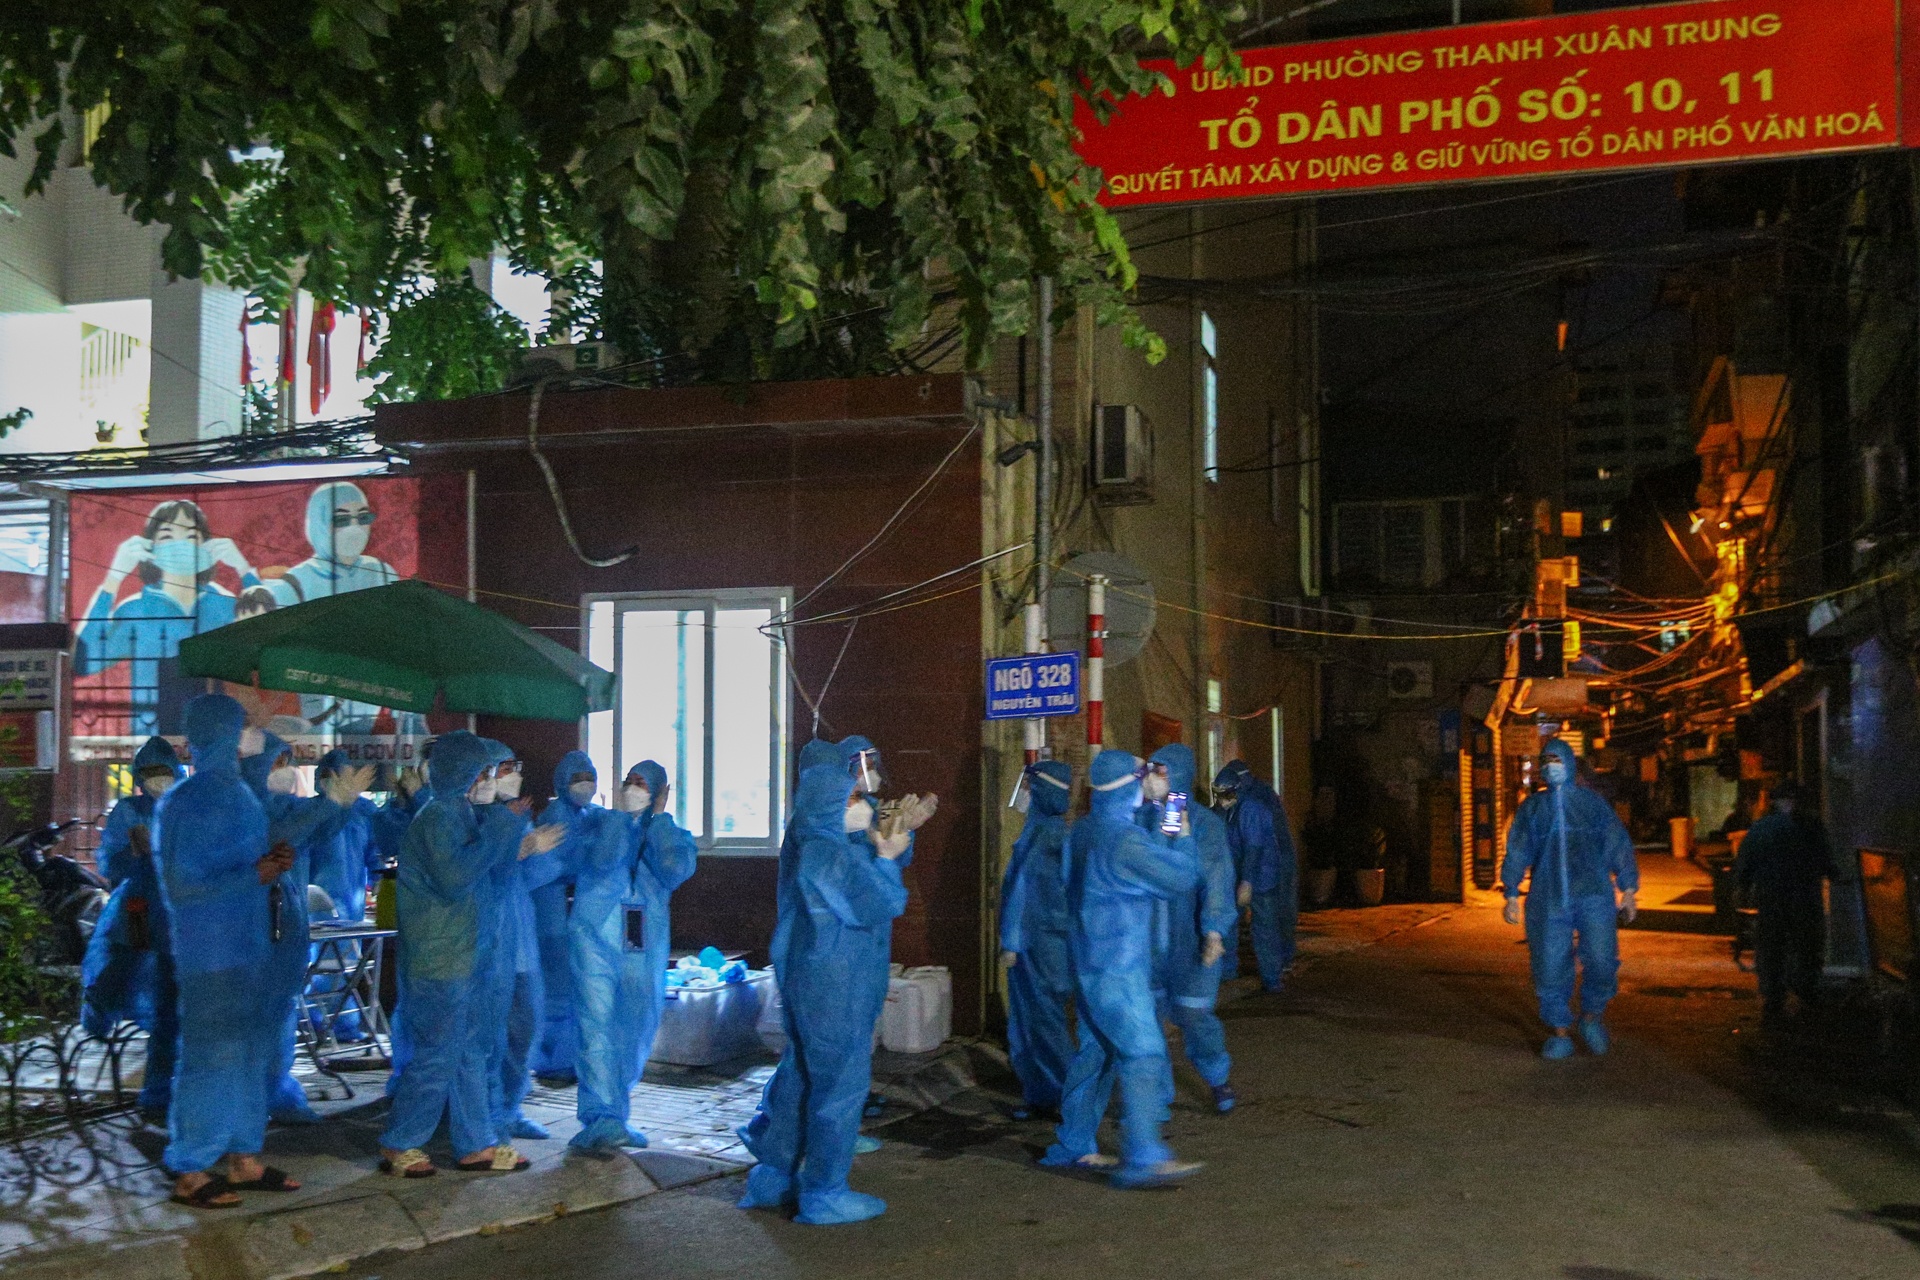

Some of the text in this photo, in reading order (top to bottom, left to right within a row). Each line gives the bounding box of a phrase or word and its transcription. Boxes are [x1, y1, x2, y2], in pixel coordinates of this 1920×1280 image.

[1284, 50, 1424, 84] PHƯỜNG
[1432, 38, 1543, 69] THANH
[1554, 25, 1652, 57] XUÂN
[1662, 13, 1782, 46] TRUNG
[1199, 68, 1774, 151] TỔ DÂN PHỐ SỐ: 10, 11
[1108, 103, 1884, 195] QUYẾT TÂM XÂY DỤNG & GIỮ VỮNG TỔ DÂN PHỐ VĂN HOÁ
[992, 693, 1042, 711] NGUYỄN
[994, 662, 1072, 692] NGÕ 328
[363, 743, 413, 760] COVD
